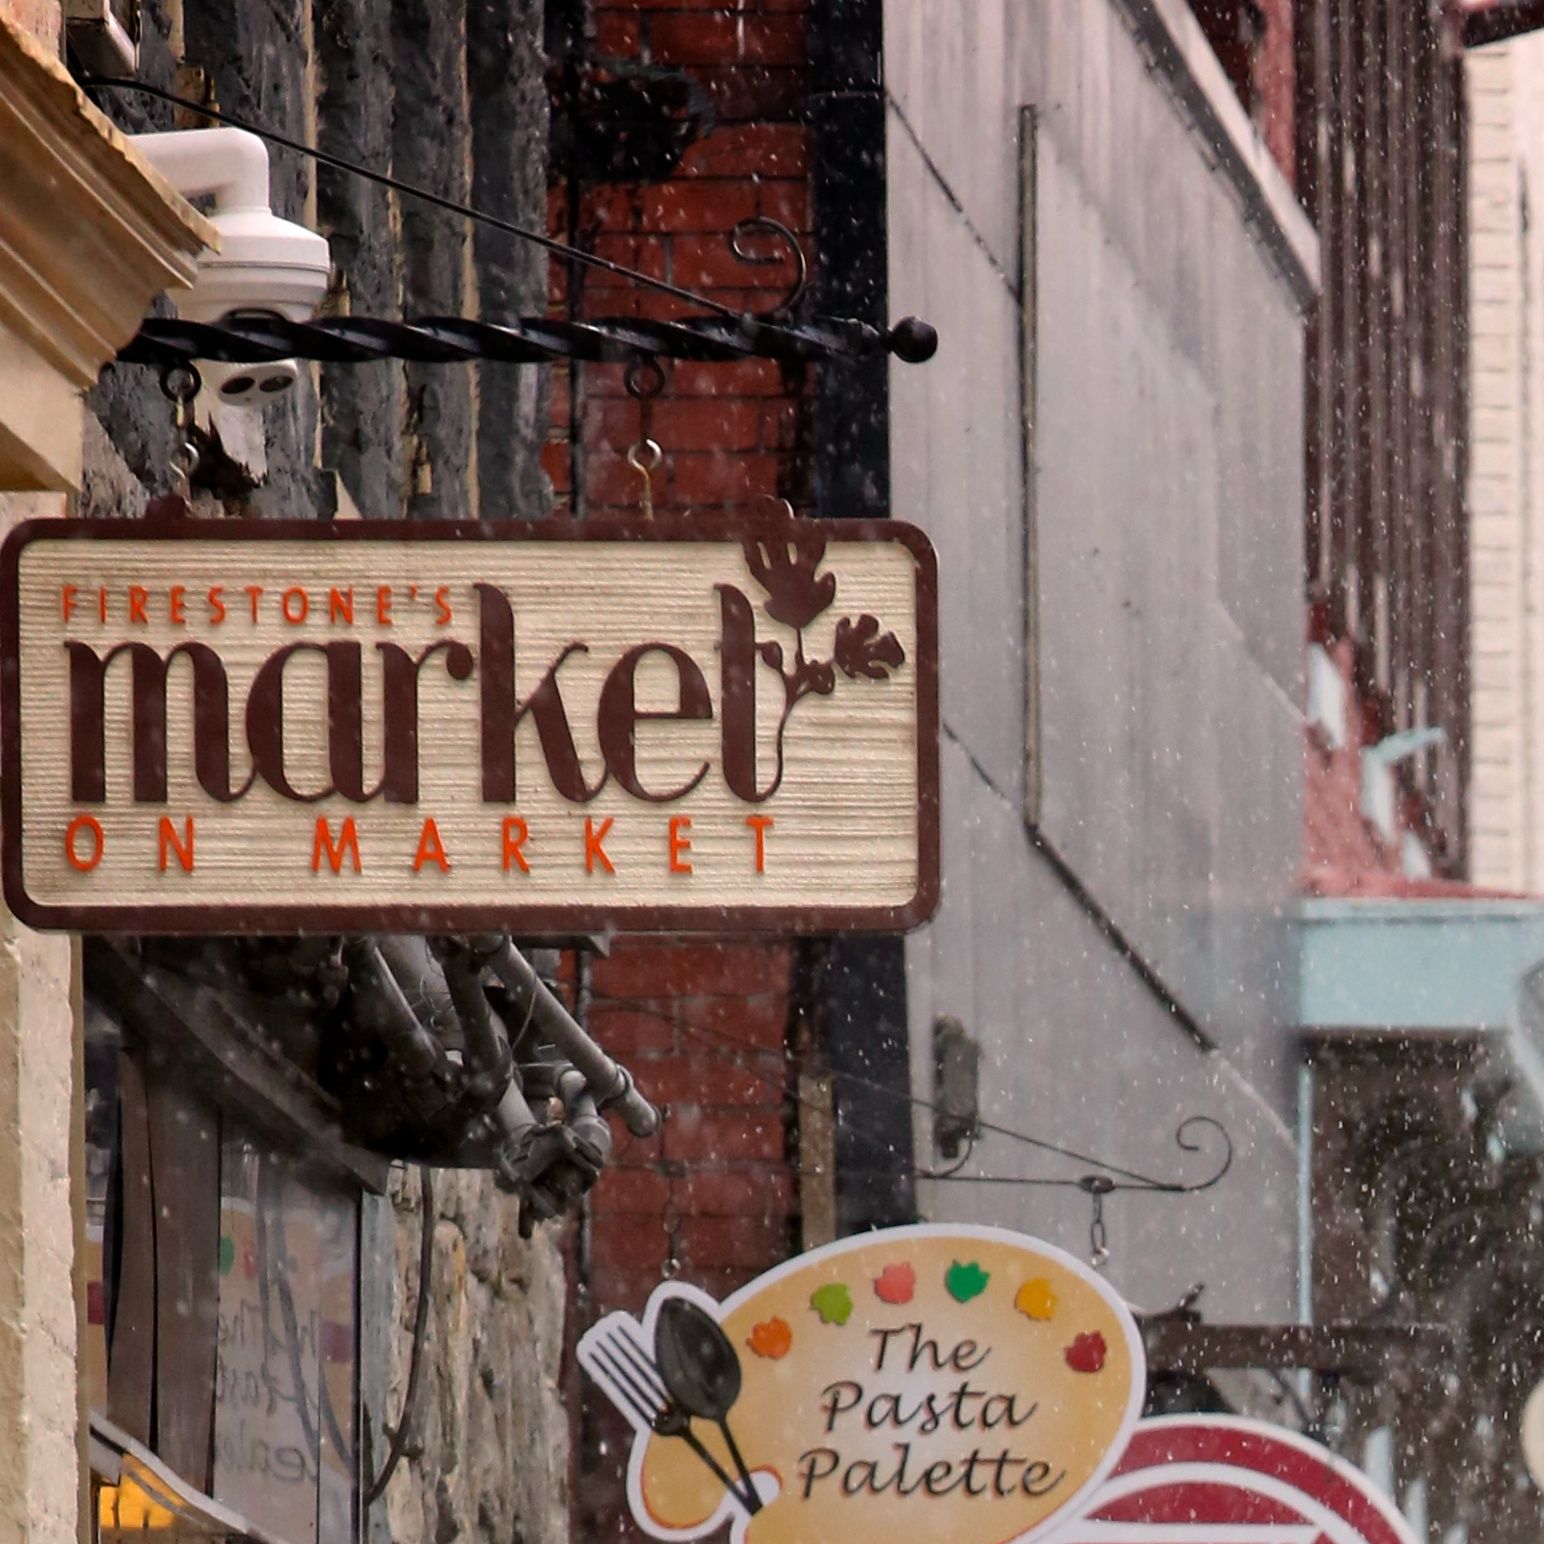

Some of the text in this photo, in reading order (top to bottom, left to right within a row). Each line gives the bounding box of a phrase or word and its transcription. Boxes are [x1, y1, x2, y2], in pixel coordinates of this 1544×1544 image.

[61, 584, 455, 627] FIRESTONE'S
[63, 582, 786, 805] market
[64, 815, 776, 876] ON MARKET
[868, 1321, 996, 1374] The
[820, 1380, 1042, 1437] Pasta
[798, 1440, 1070, 1499] Palette
